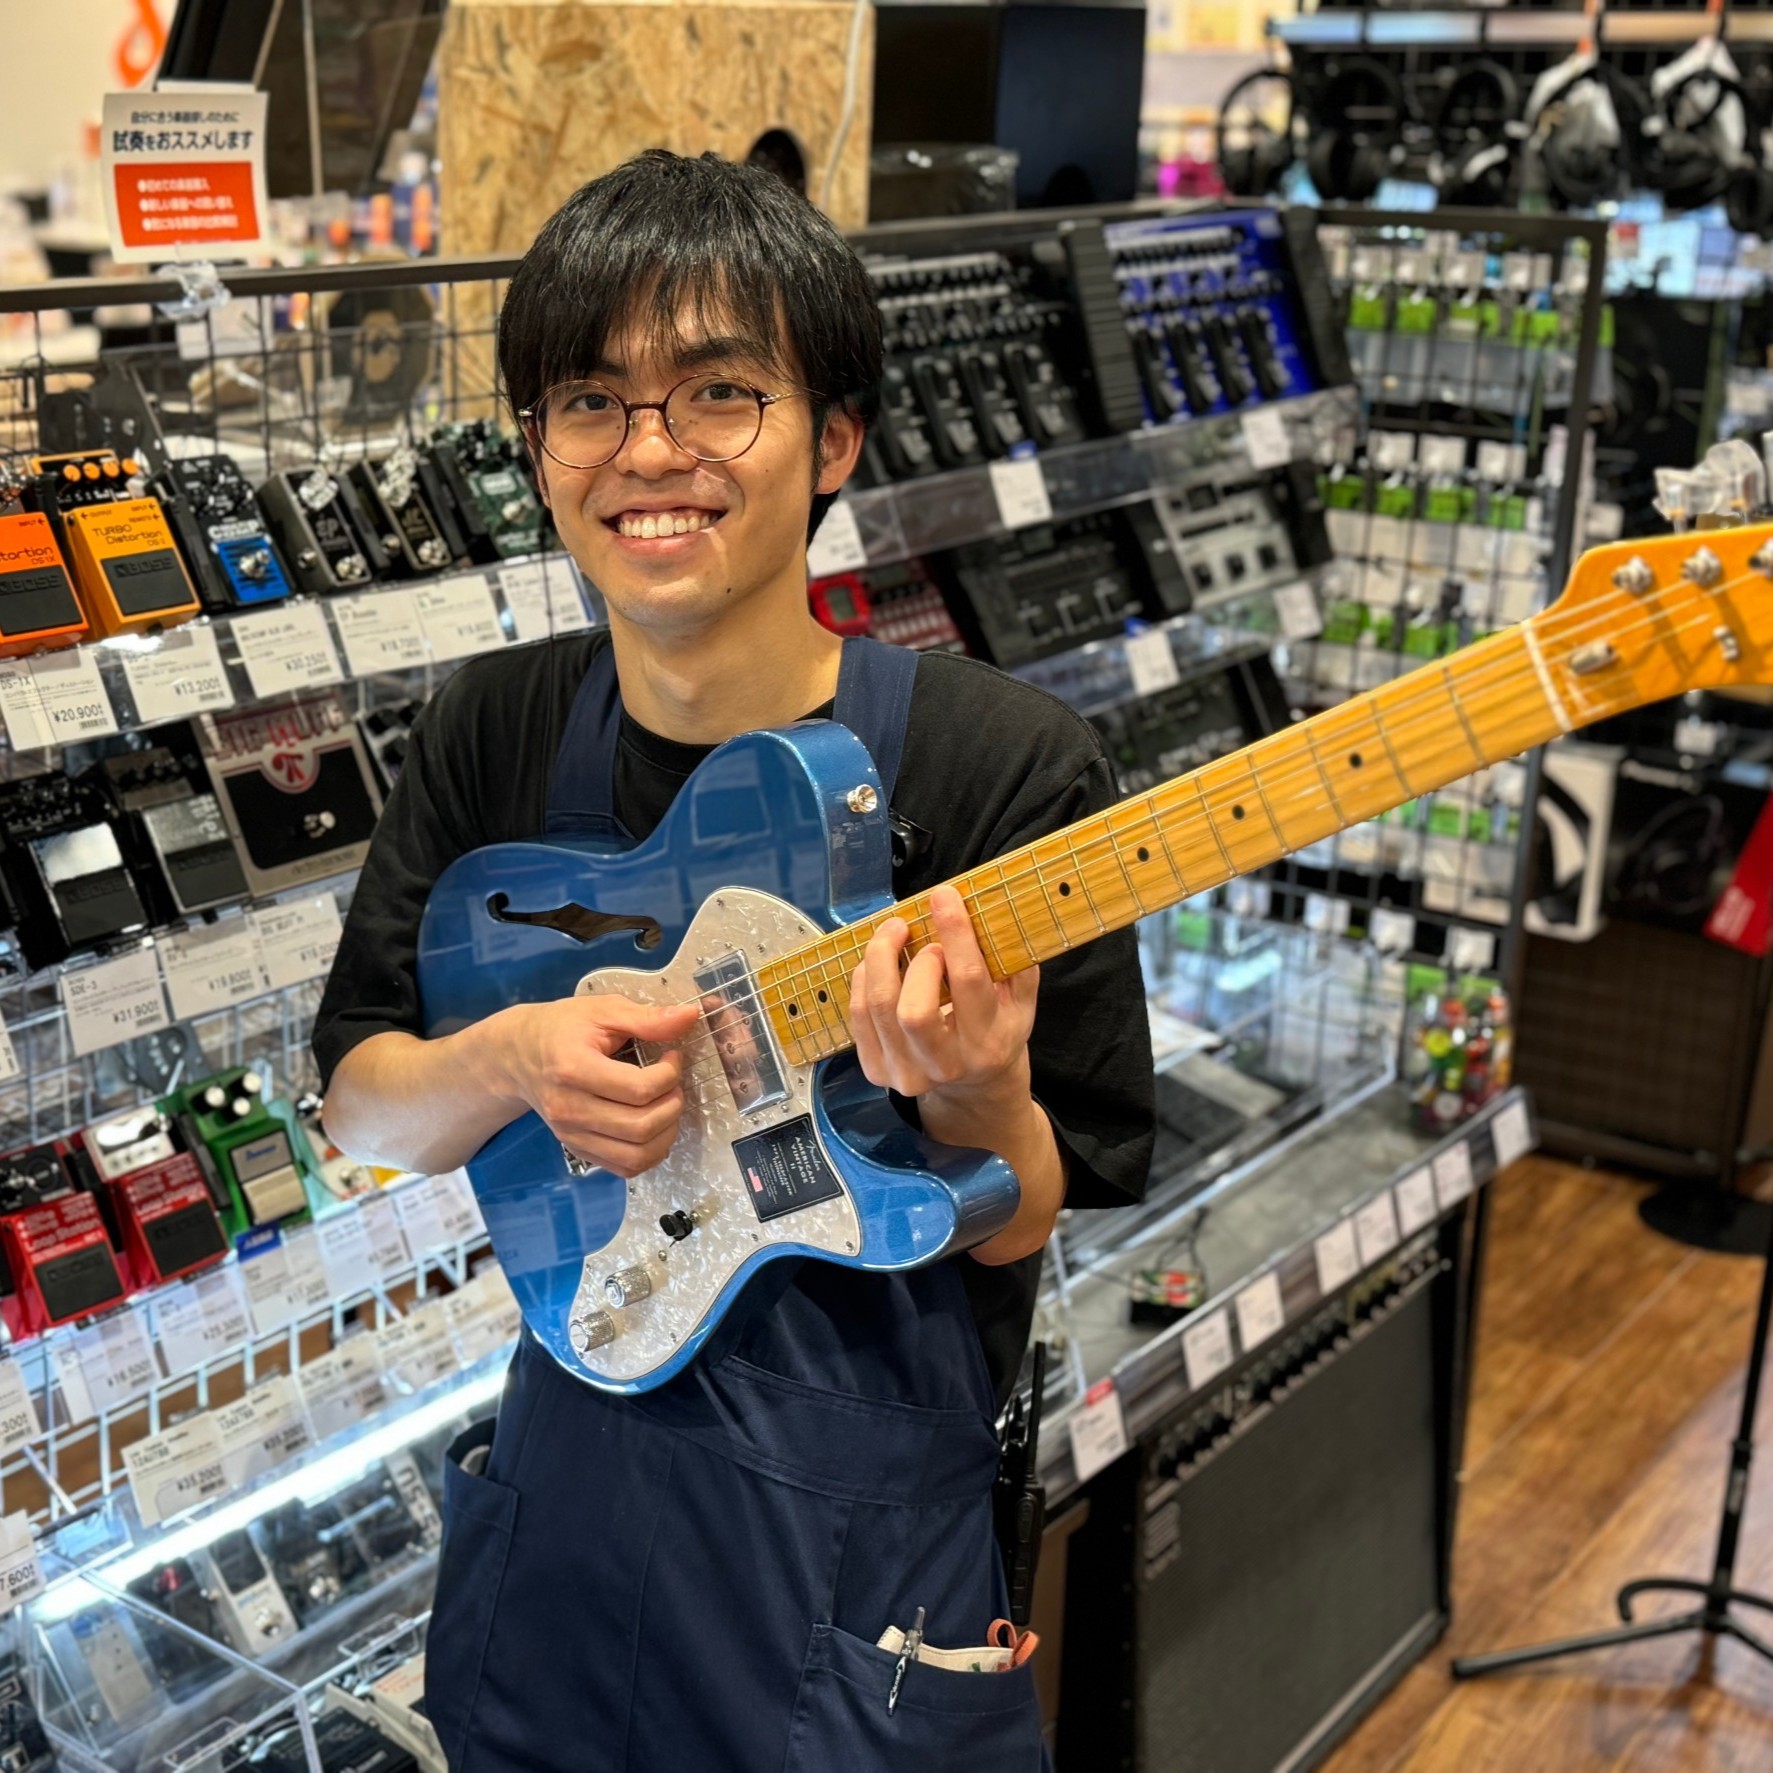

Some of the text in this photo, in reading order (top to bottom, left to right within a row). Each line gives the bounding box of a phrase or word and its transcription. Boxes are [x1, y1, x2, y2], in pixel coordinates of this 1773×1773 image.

[113, 131, 253, 152] 試奏をおススメします
[92, 524, 133, 537] TURBO
[105, 530, 163, 545] Distortion
[791, 1143, 809, 1183] VINTAGE
[795, 1136, 816, 1184] AMERICAN
